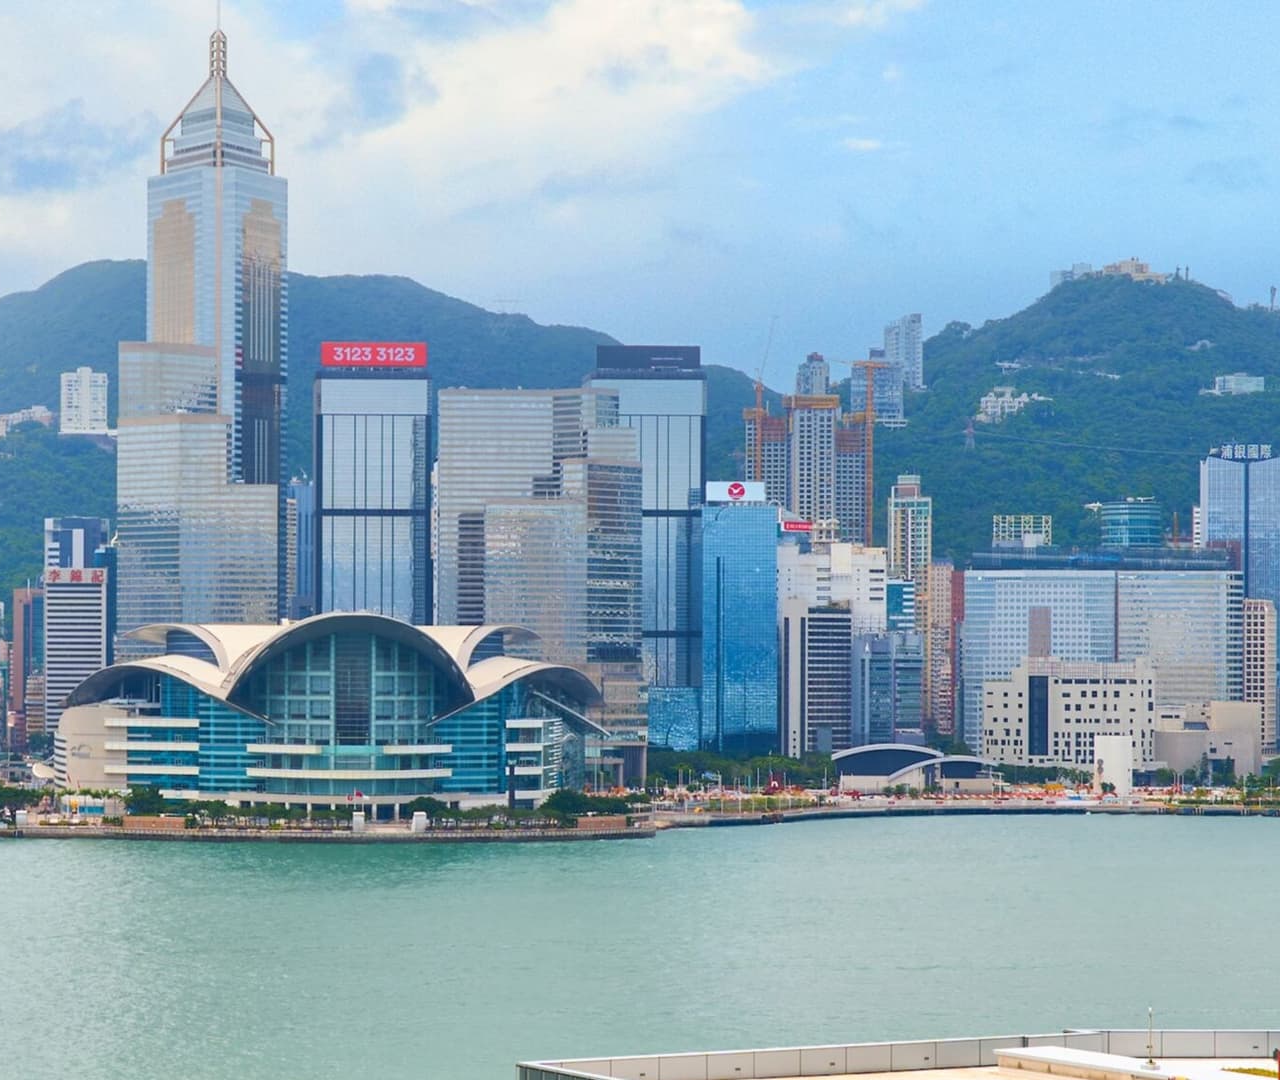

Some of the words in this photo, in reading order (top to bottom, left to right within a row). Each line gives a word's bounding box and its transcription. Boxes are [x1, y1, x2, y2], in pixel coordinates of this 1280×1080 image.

[333, 347, 372, 361] 3123
[376, 347, 415, 361] 3123
[1220, 443, 1272, 459] 浦銀國際
